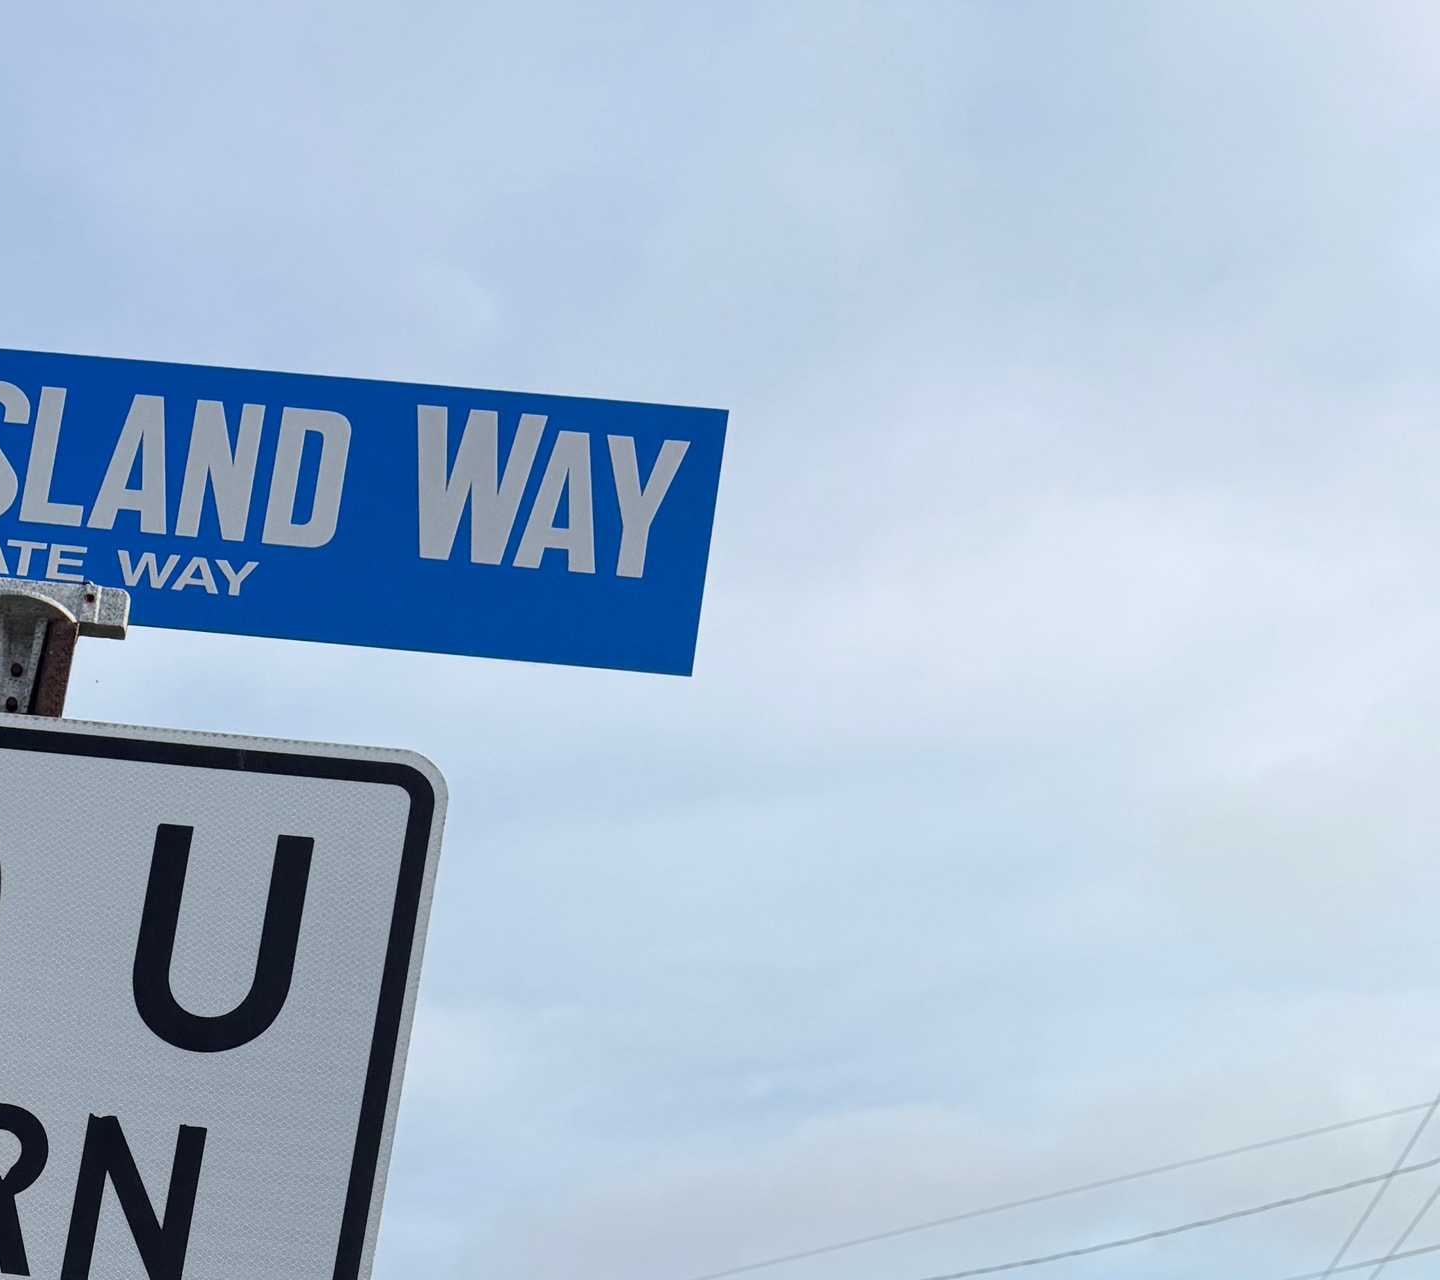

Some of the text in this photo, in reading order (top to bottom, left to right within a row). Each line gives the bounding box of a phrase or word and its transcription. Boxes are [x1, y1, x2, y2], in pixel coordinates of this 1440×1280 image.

[118, 552, 259, 598] WAY
[416, 404, 691, 579] WAY
[132, 823, 315, 1054] U
